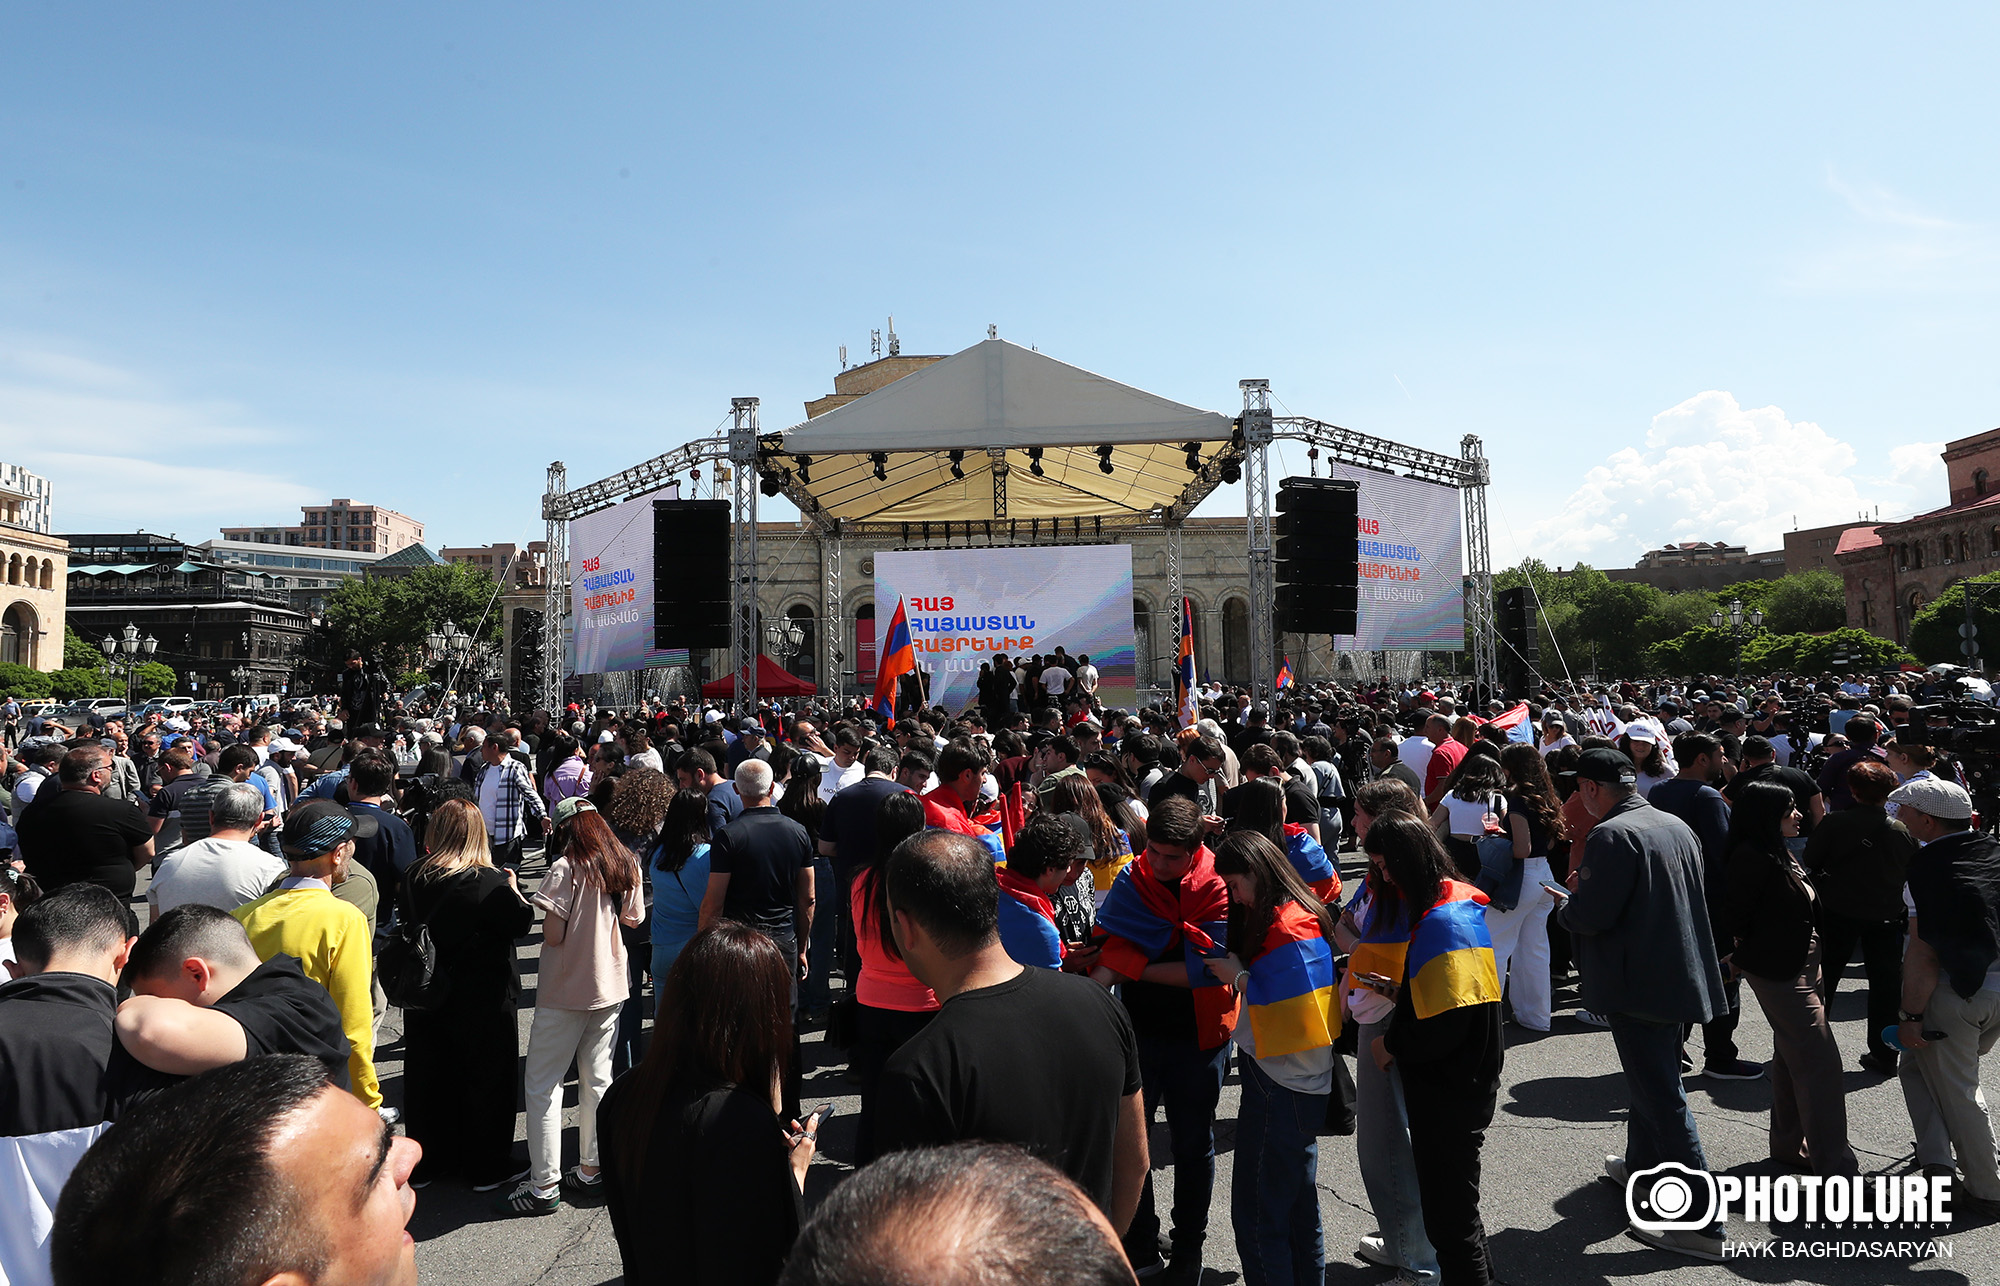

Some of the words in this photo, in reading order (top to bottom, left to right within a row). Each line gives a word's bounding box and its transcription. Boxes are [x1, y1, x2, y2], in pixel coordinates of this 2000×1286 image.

[583, 556, 600, 572] ՀԱՅ
[584, 568, 635, 591] ՀԱՅԱՍՏԱՆ
[584, 588, 635, 610] ՀԱՅՐԵՆԻՔ
[910, 596, 955, 612] ՀԱՅ
[597, 609, 639, 626] ԱՍՏՎԱԾ
[910, 615, 1036, 632] ՀԱՅԱՍՏԱՆ
[913, 635, 1034, 653] ՀԱՅՐԵՆԻՔ
